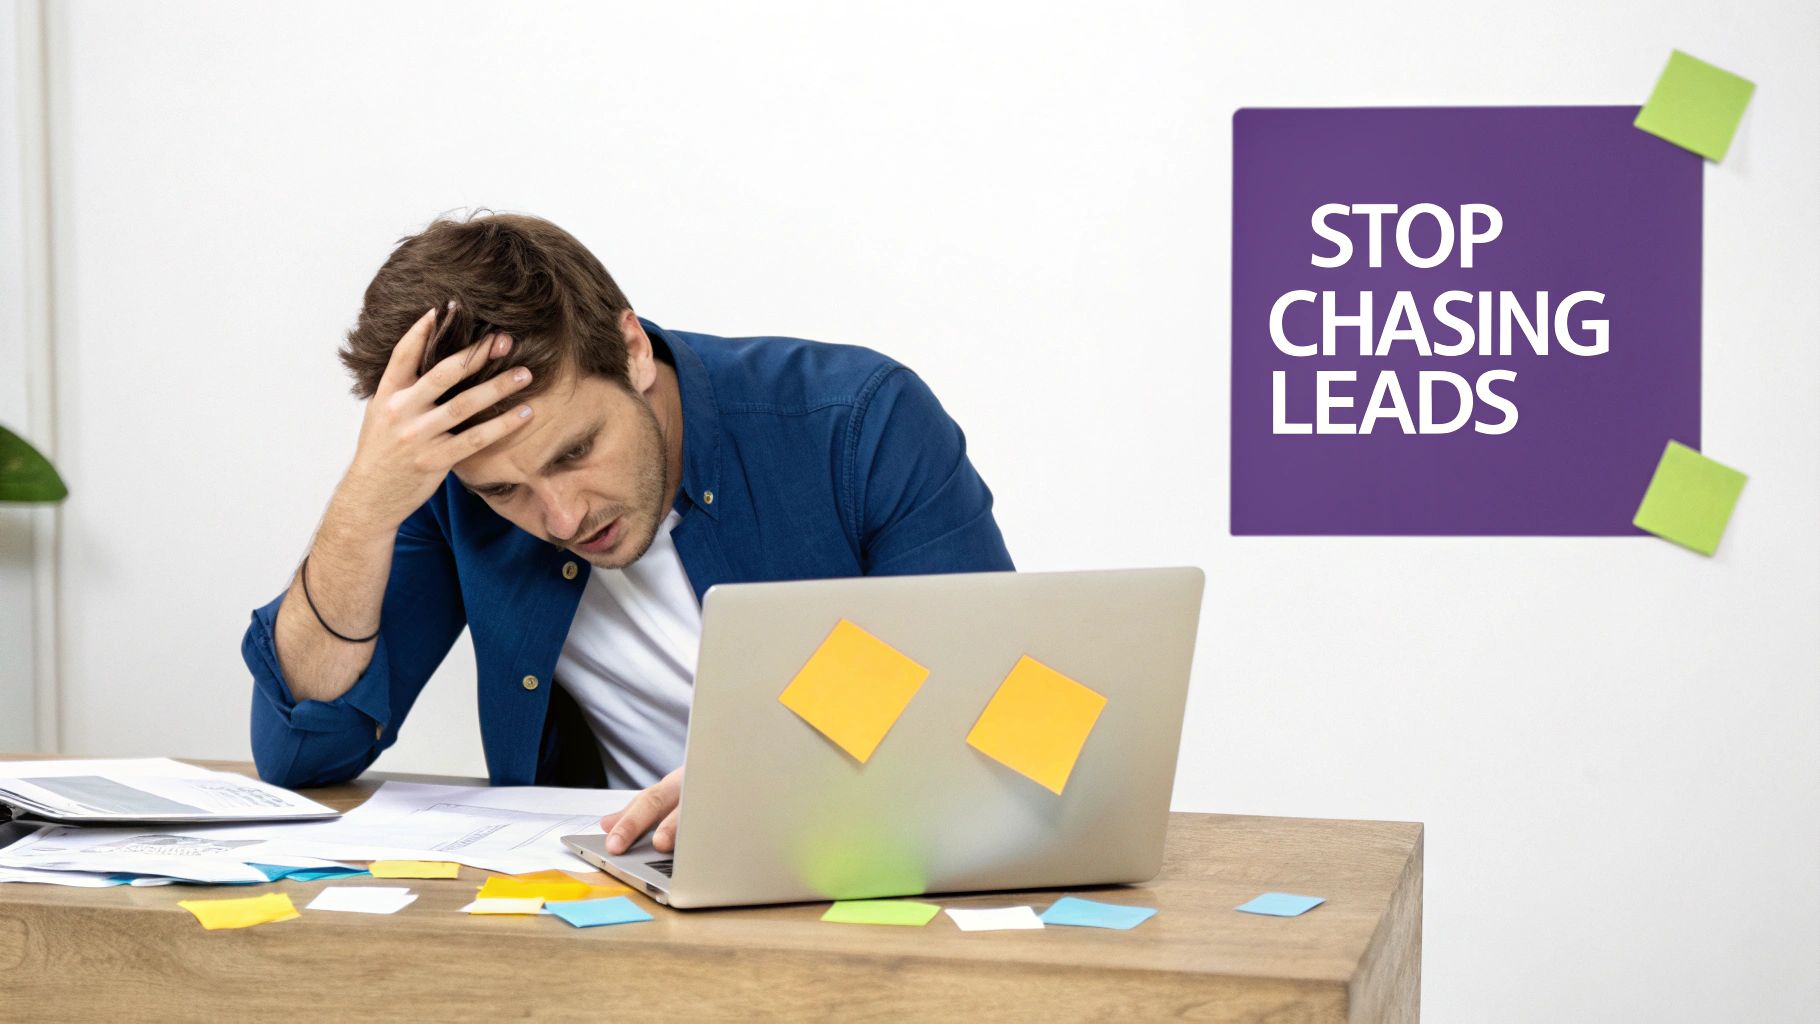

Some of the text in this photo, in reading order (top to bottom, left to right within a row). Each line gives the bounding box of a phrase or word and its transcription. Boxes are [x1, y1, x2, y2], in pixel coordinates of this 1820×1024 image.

[1310, 202, 1504, 269] STOP
[1269, 289, 1610, 357] CHASING
[1272, 369, 1519, 435] LEADS
